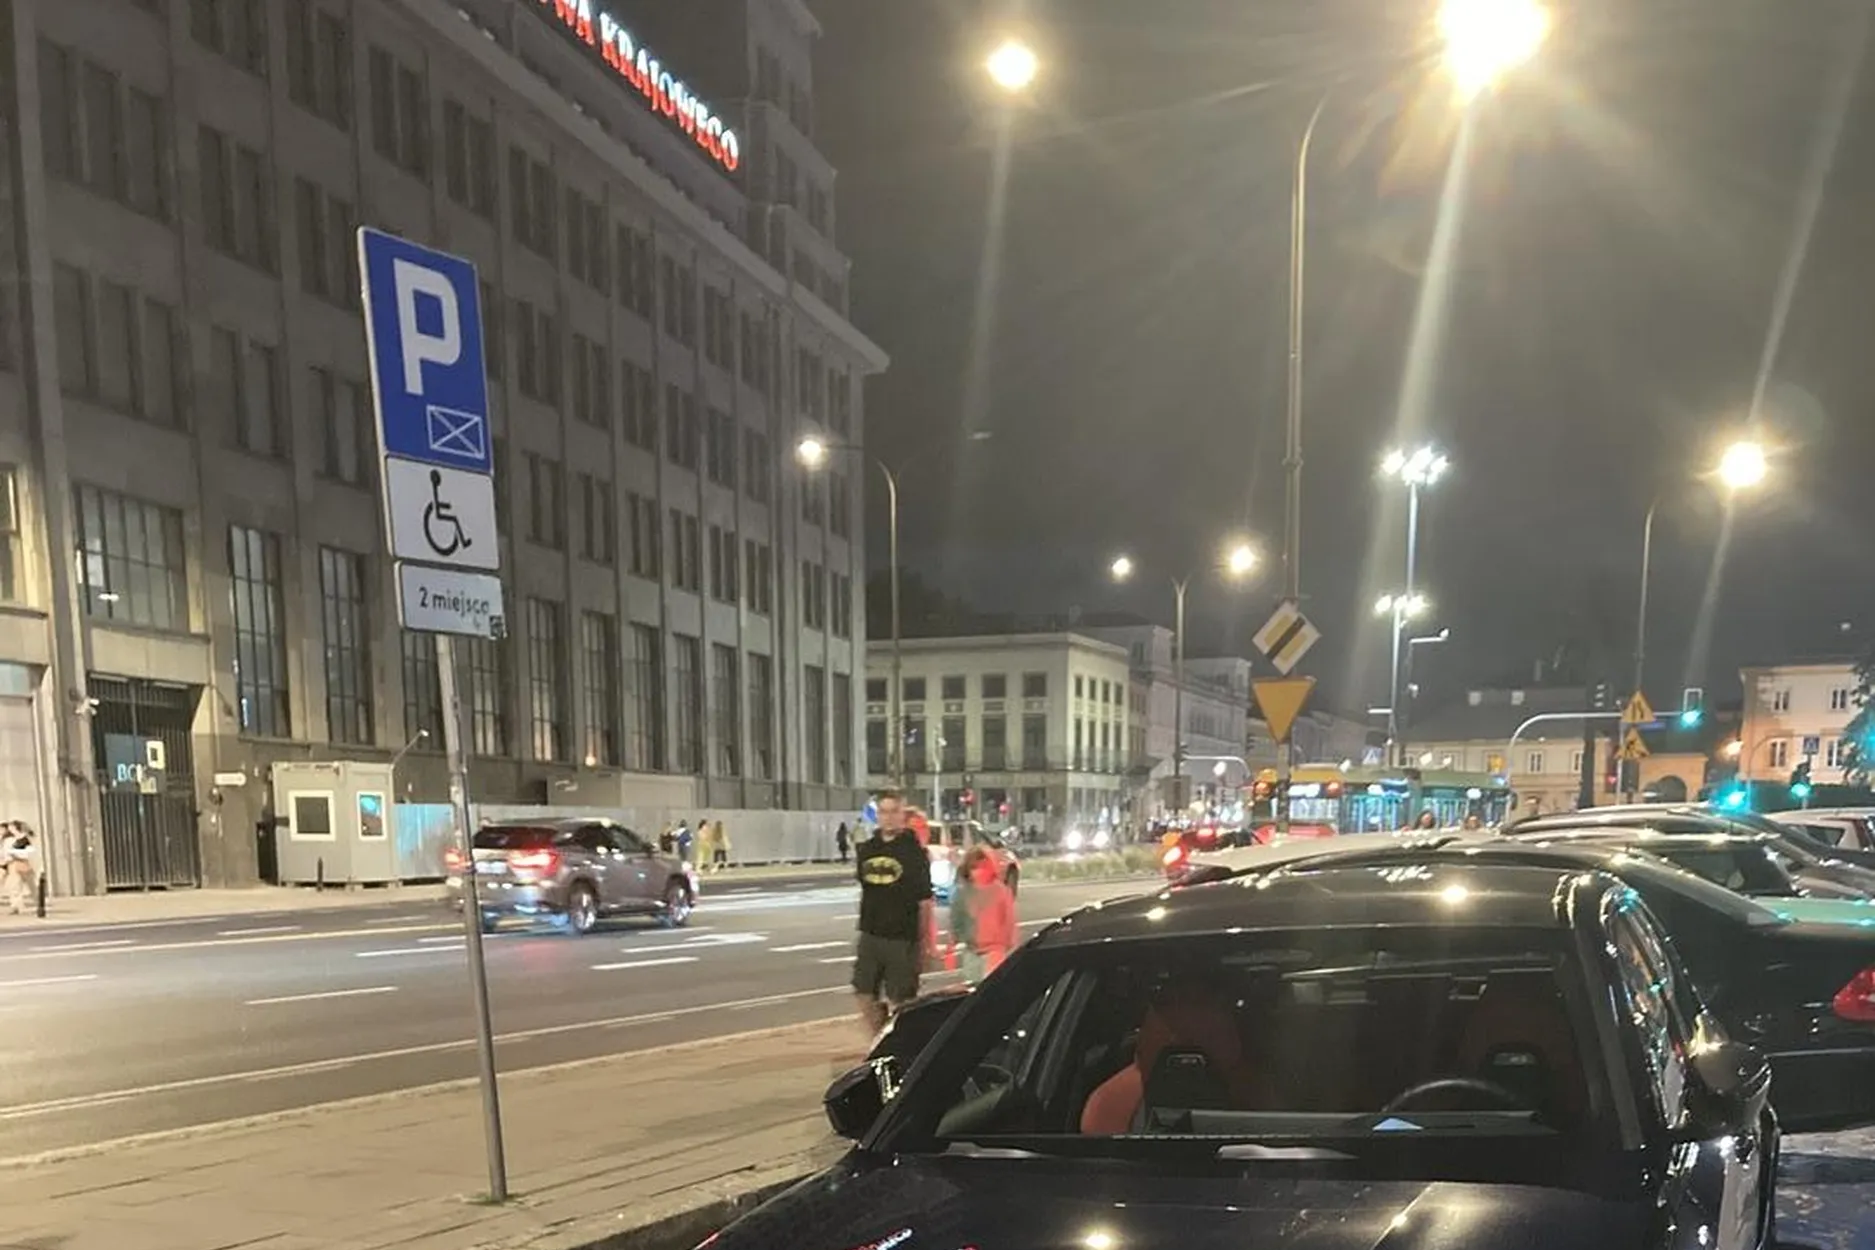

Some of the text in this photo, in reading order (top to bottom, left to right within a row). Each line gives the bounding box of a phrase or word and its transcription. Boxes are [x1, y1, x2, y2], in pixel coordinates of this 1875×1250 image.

[600, 12, 738, 171] KRAJOWEGO
[393, 258, 461, 395] P
[419, 586, 428, 609] 2
